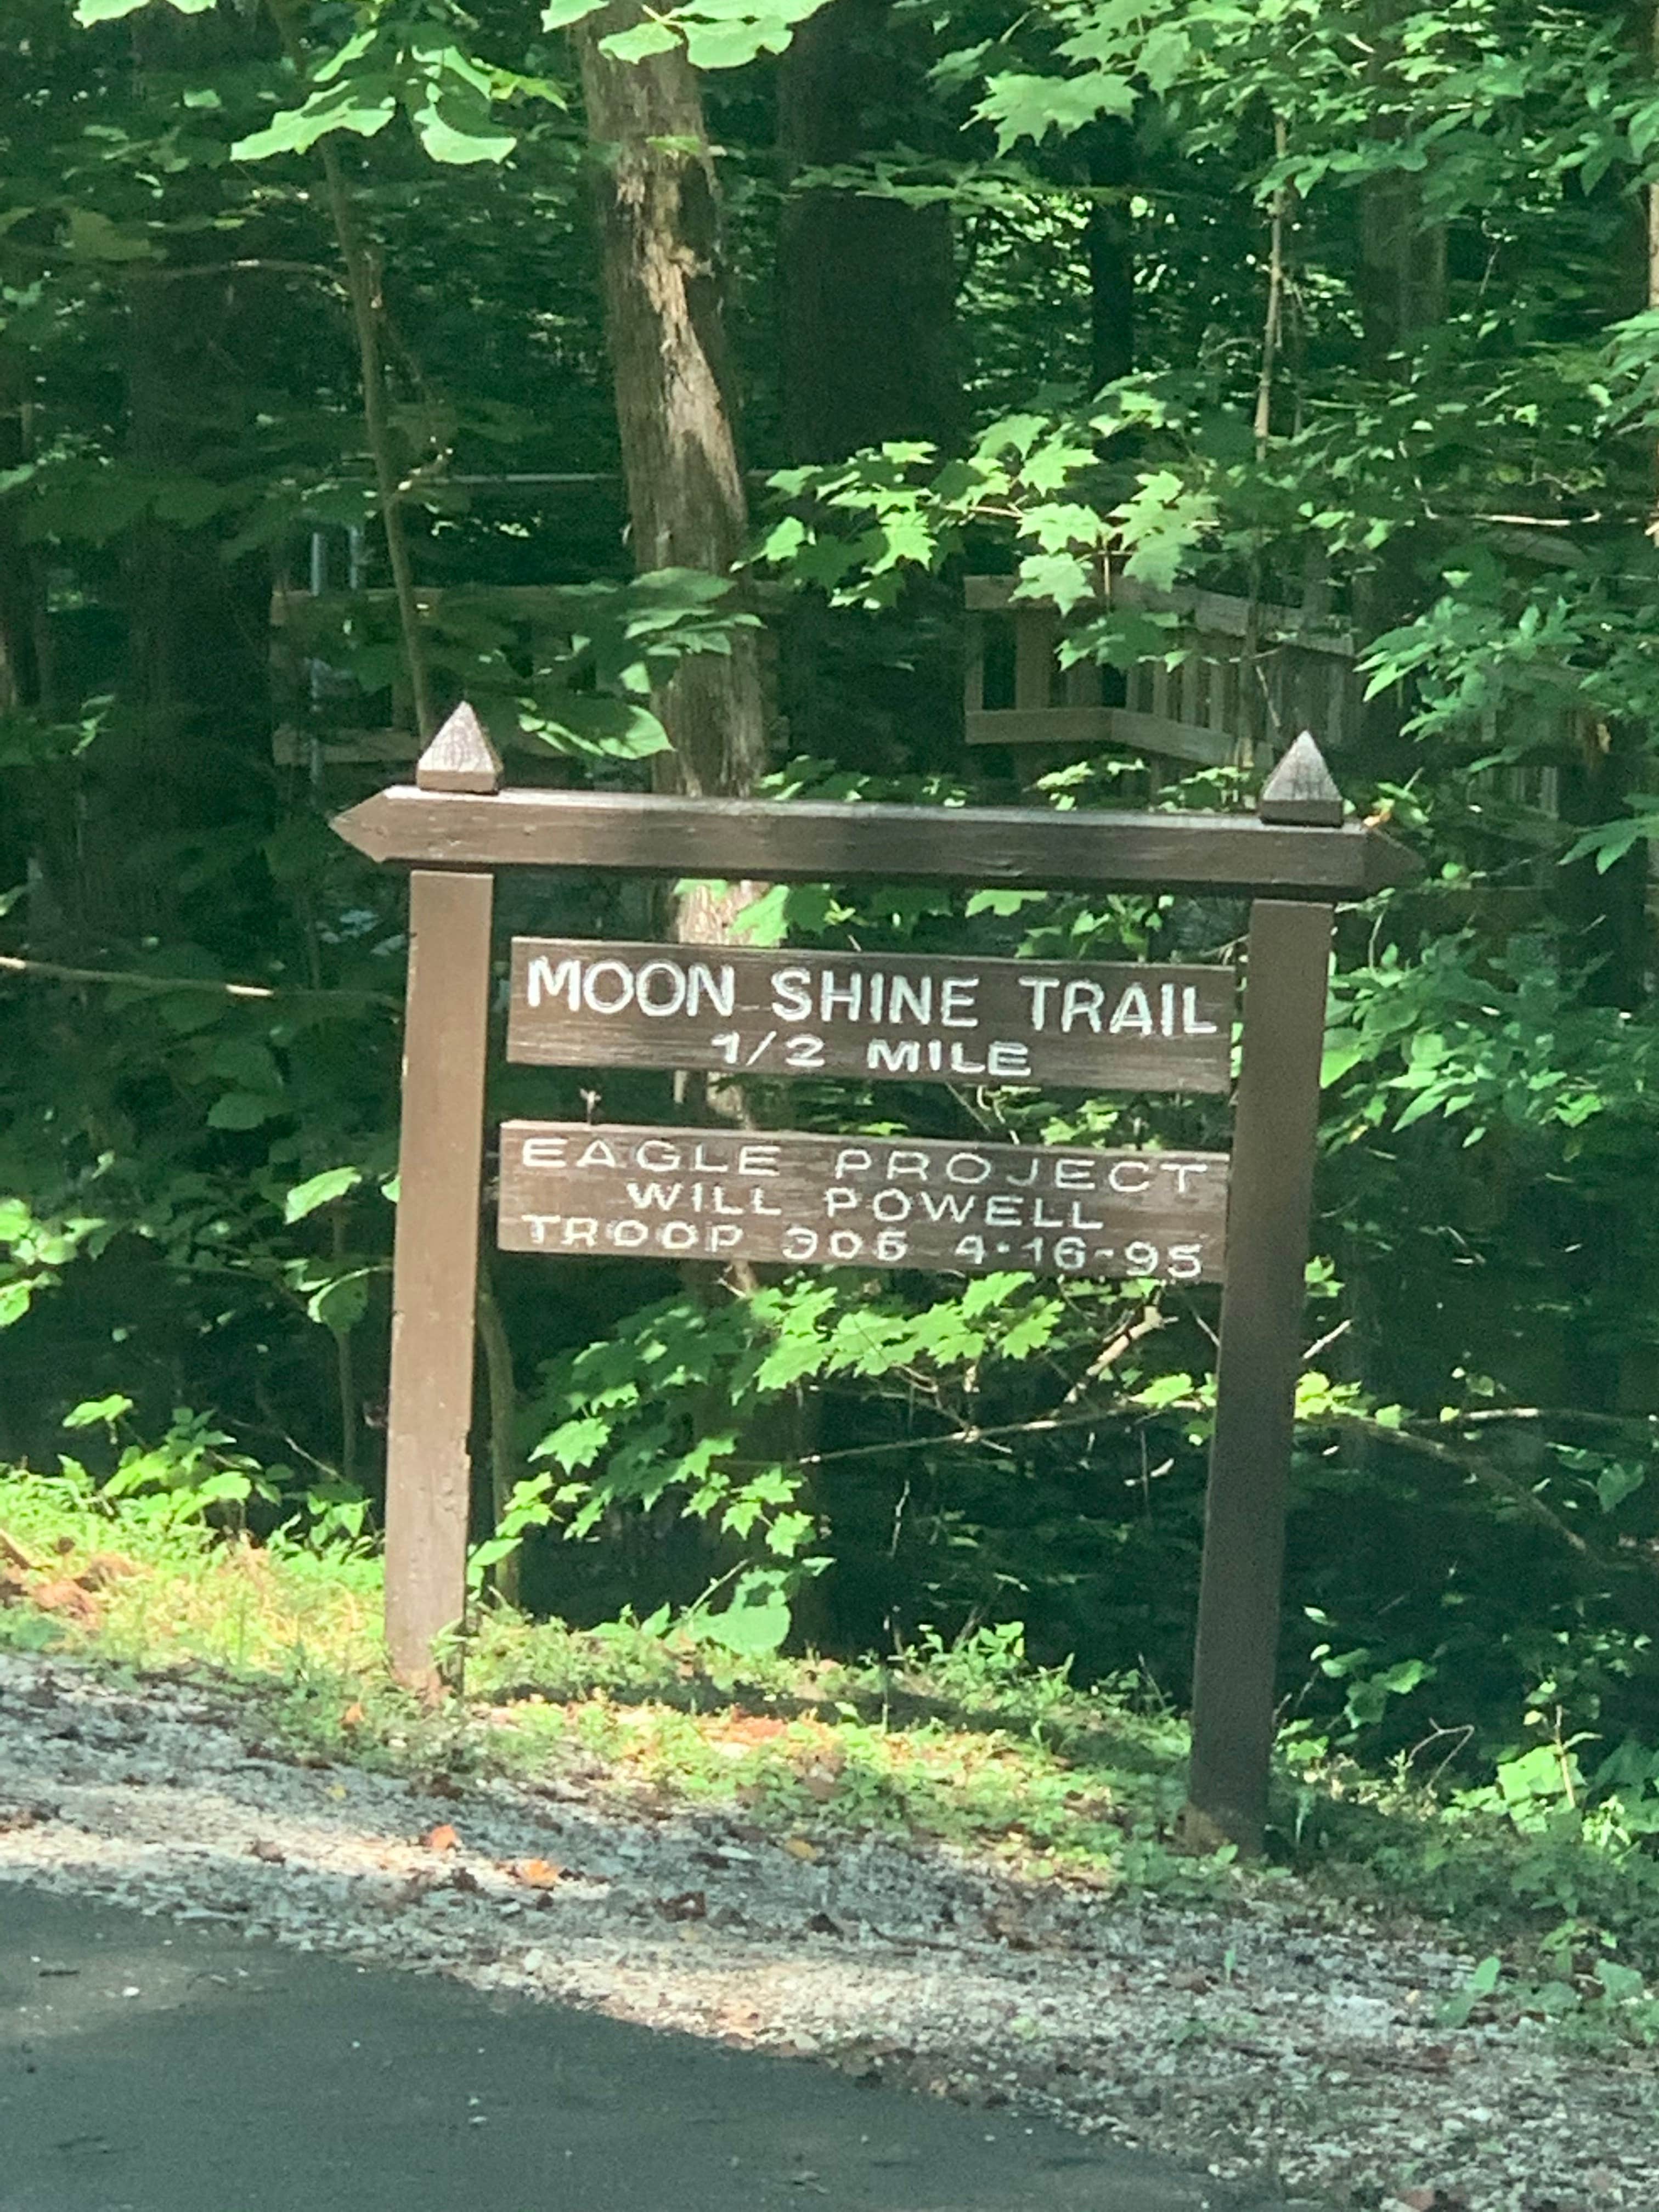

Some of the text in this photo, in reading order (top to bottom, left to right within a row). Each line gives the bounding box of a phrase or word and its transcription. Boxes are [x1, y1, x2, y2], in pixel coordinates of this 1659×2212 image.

[527, 955, 1217, 1036] MOON SHINE TRAIL
[711, 1030, 1031, 1076] 1/2 MILE
[522, 1138, 1207, 1193] EAGLE PROJECT
[627, 1182, 1104, 1229] WILL POWELL
[521, 1215, 743, 1252] TROOP
[782, 1227, 907, 1262] 306
